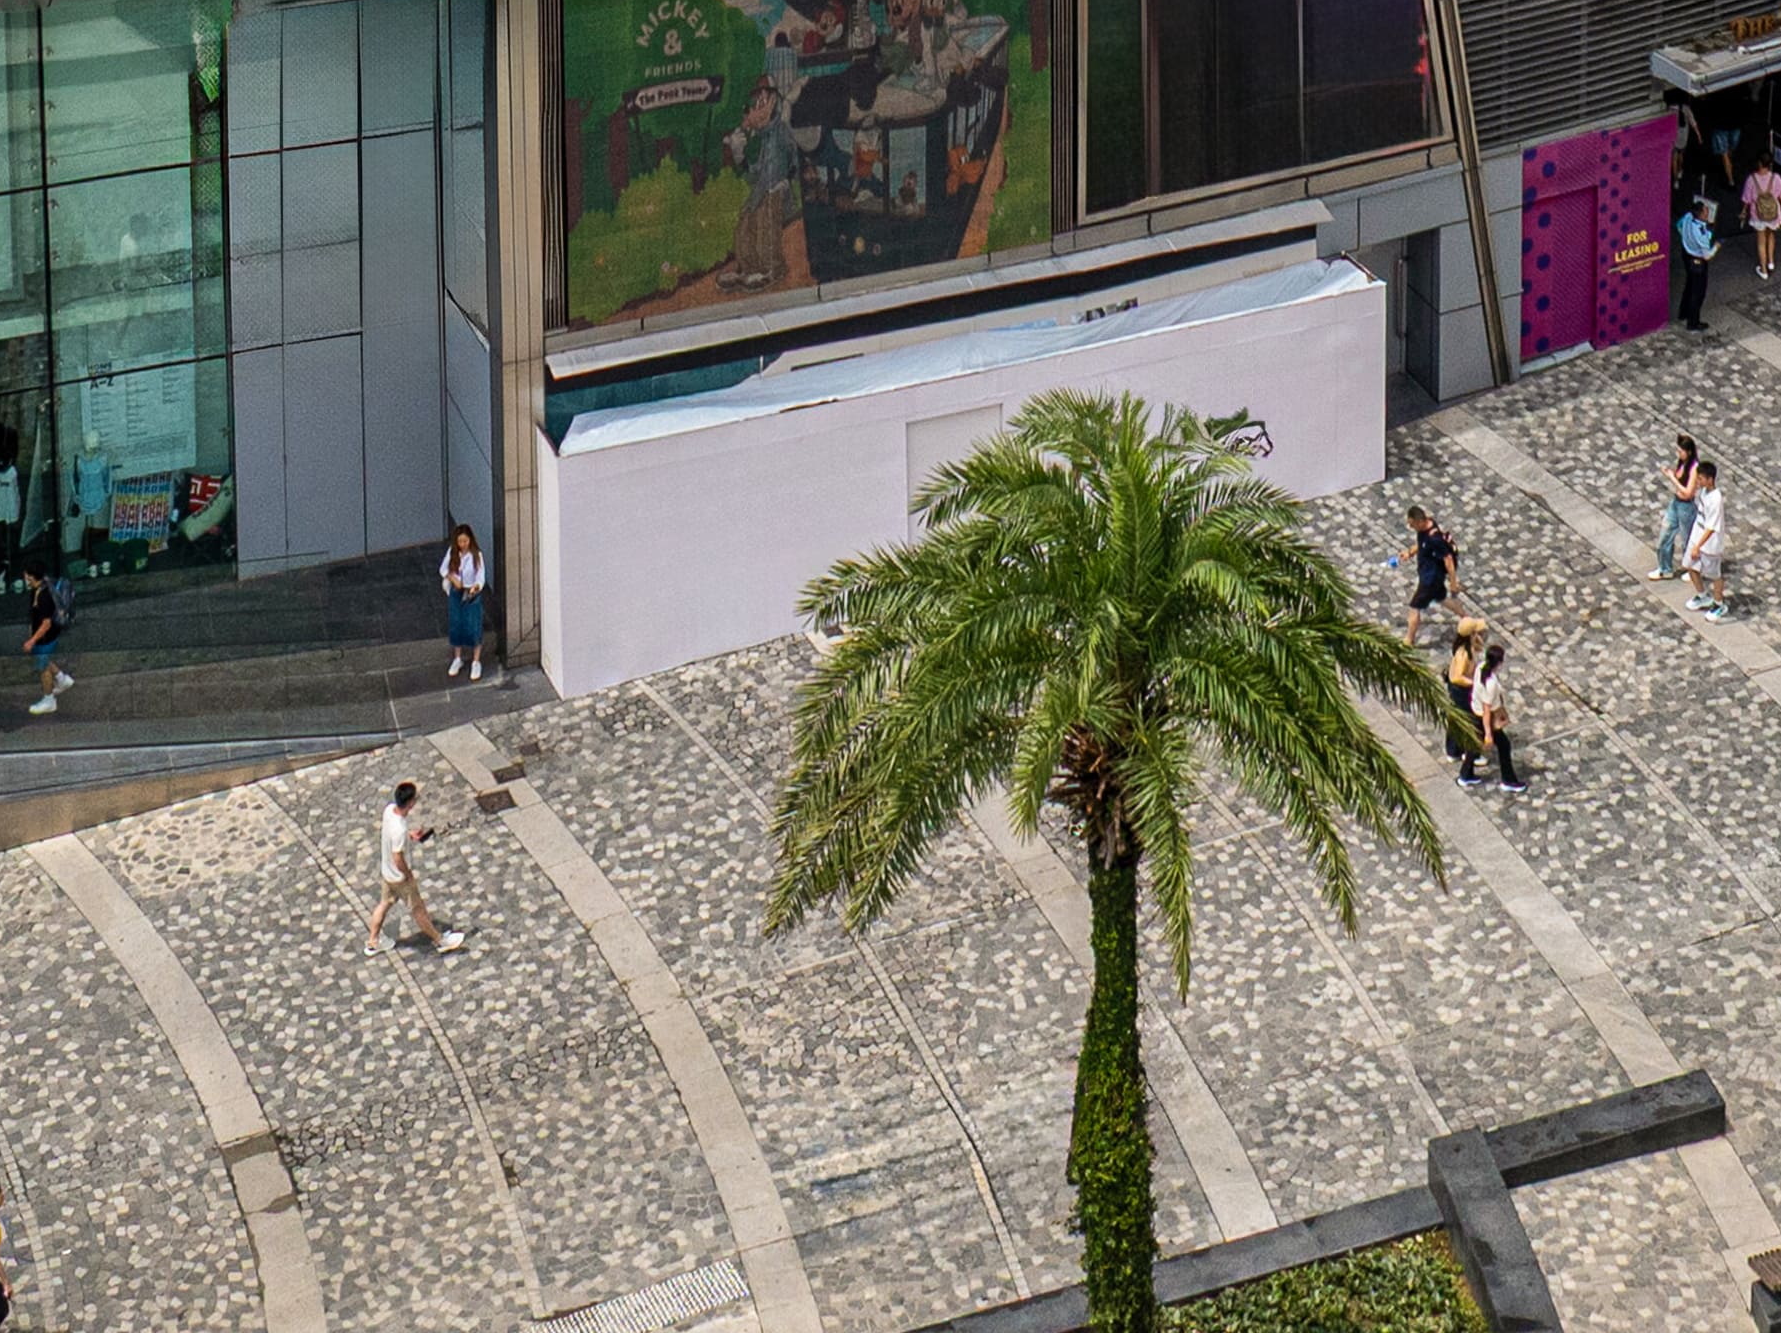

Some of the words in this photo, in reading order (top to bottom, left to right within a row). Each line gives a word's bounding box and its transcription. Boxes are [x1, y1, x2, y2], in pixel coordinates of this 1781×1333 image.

[636, 0, 710, 47] MICKEY
[664, 29, 682, 56] &
[645, 60, 702, 77] FRIENDS
[1627, 230, 1647, 245] FOR
